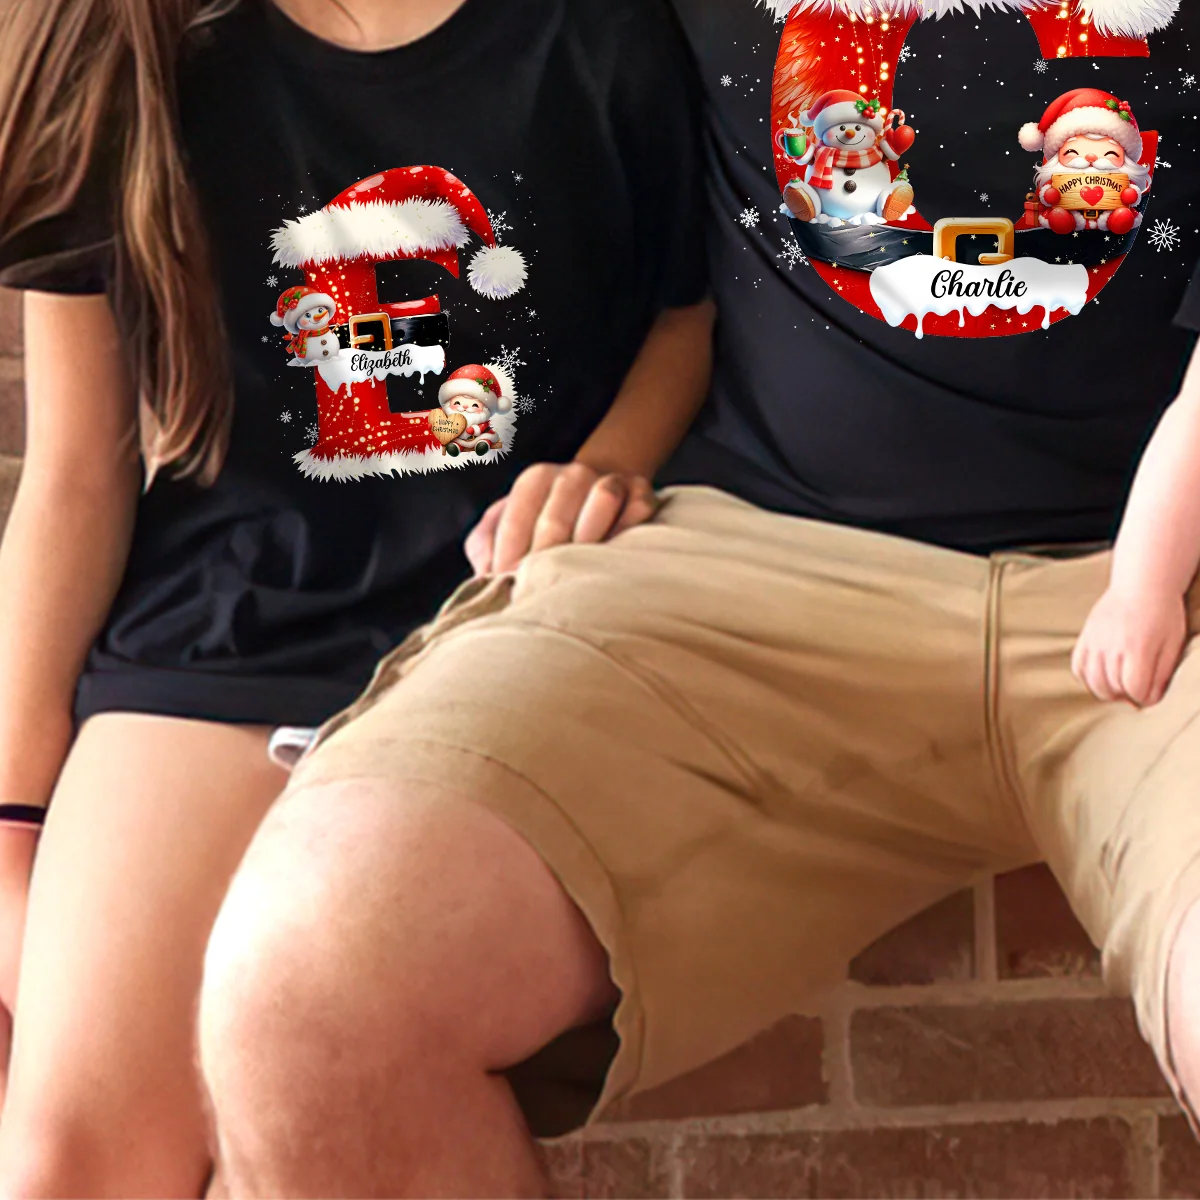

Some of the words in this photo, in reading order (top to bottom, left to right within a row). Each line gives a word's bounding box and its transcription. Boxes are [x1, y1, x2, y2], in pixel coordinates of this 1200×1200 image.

[1059, 177, 1083, 194] HAPPY
[1085, 176, 1123, 193] CHRISTMAS
[931, 269, 1028, 298] Charlie
[351, 349, 412, 376] Elizabeth
